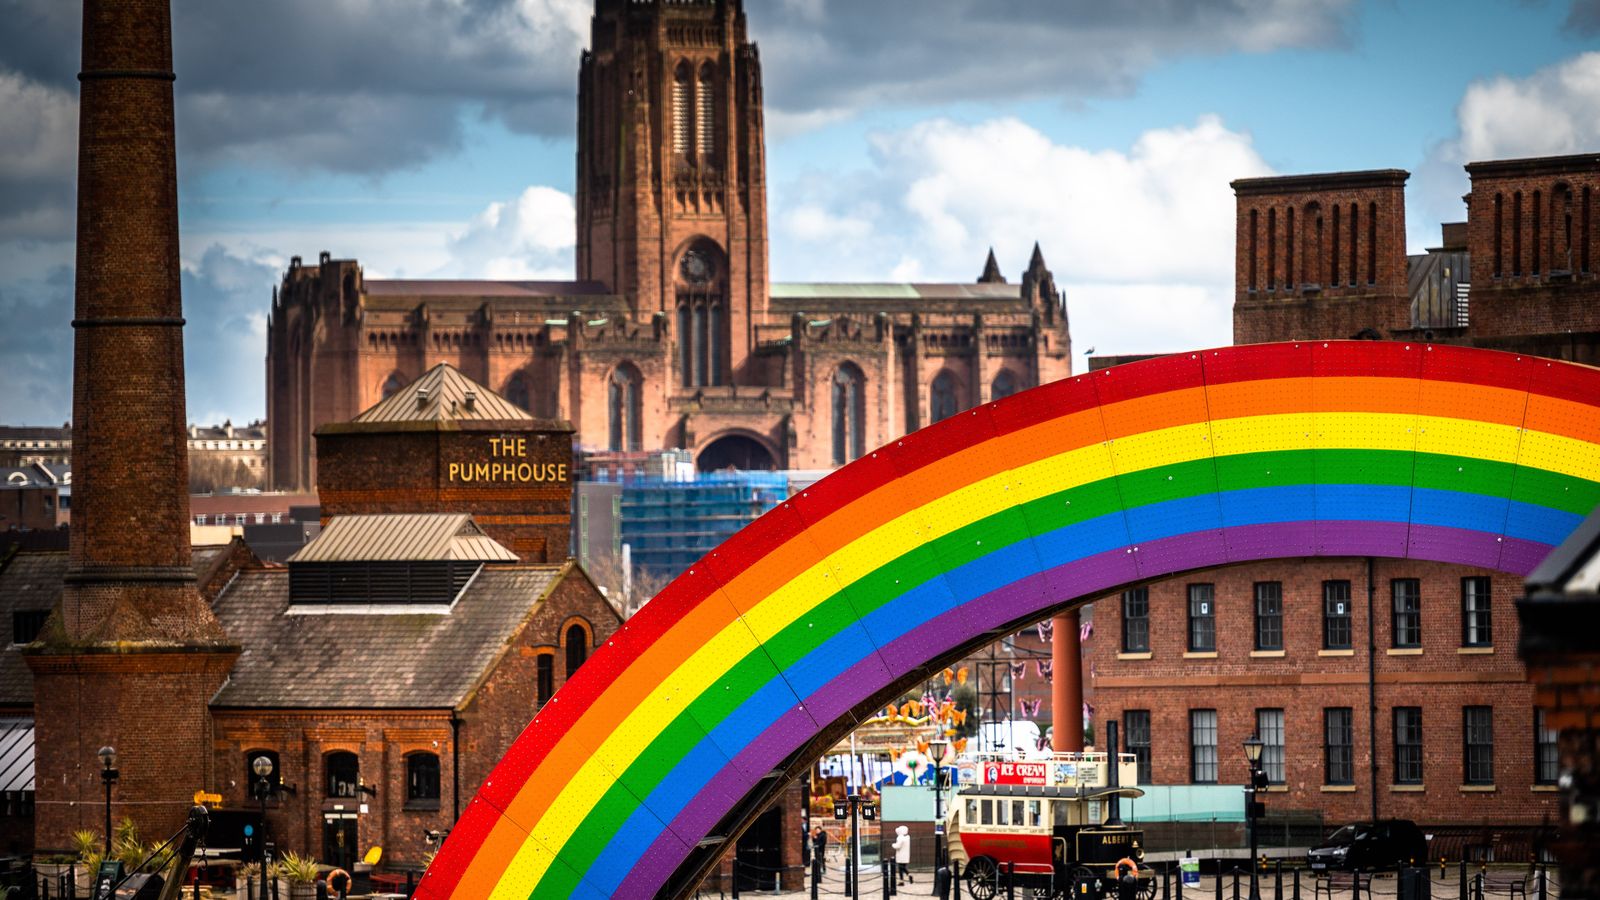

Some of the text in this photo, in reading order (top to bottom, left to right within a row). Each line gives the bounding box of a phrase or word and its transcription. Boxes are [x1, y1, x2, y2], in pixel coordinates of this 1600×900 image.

[489, 438, 526, 457] THE
[449, 463, 567, 482] PUMPHOUSE
[1001, 763, 1014, 776] ICE
[1016, 764, 1045, 777] CREAM
